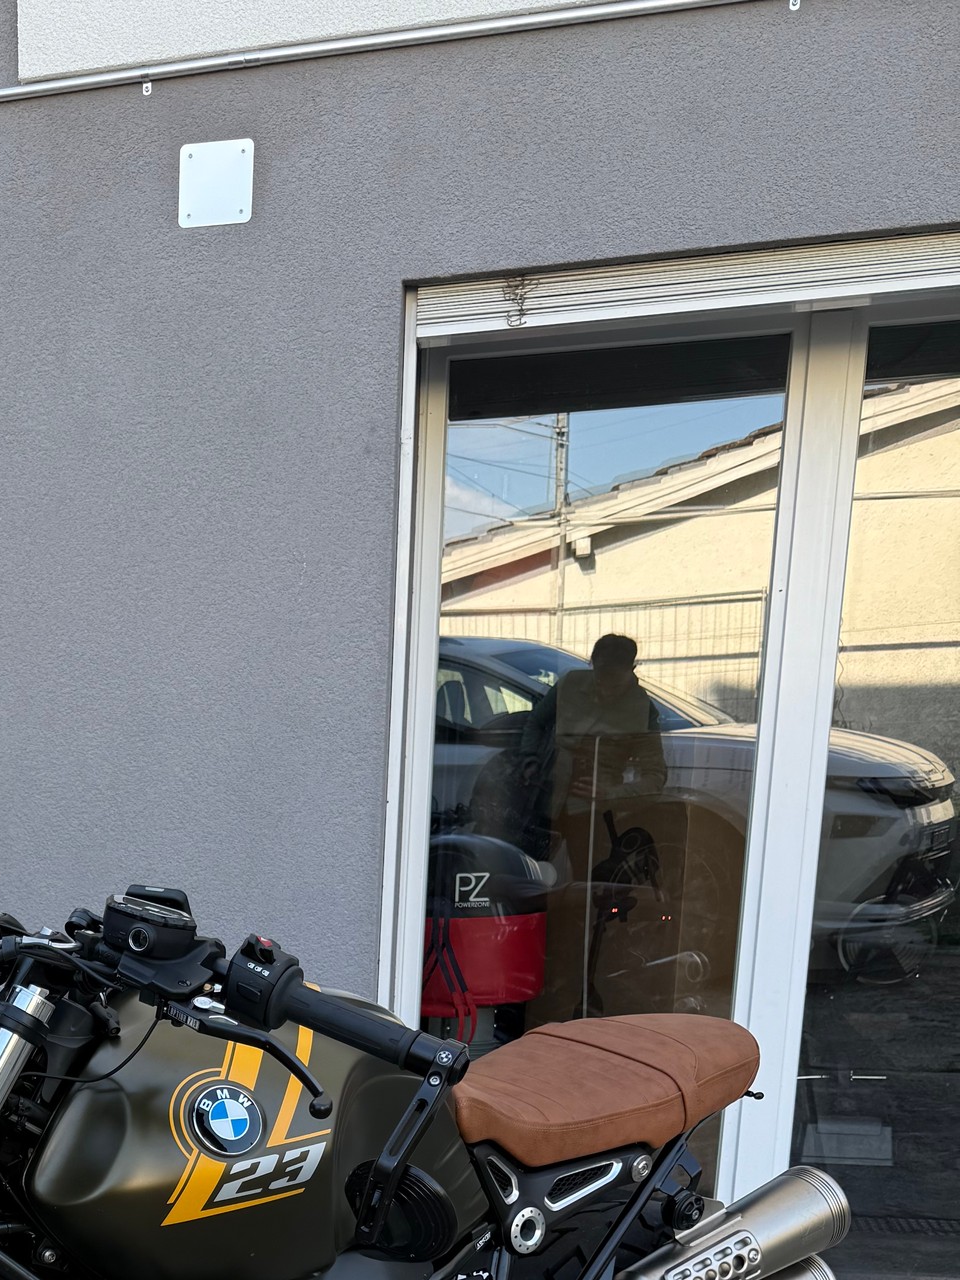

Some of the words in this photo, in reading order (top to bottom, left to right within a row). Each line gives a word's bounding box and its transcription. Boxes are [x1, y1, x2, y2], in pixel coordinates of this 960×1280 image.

[455, 872, 490, 902] PZ
[199, 1088, 252, 1112] BMW
[213, 1141, 327, 1203] 23
